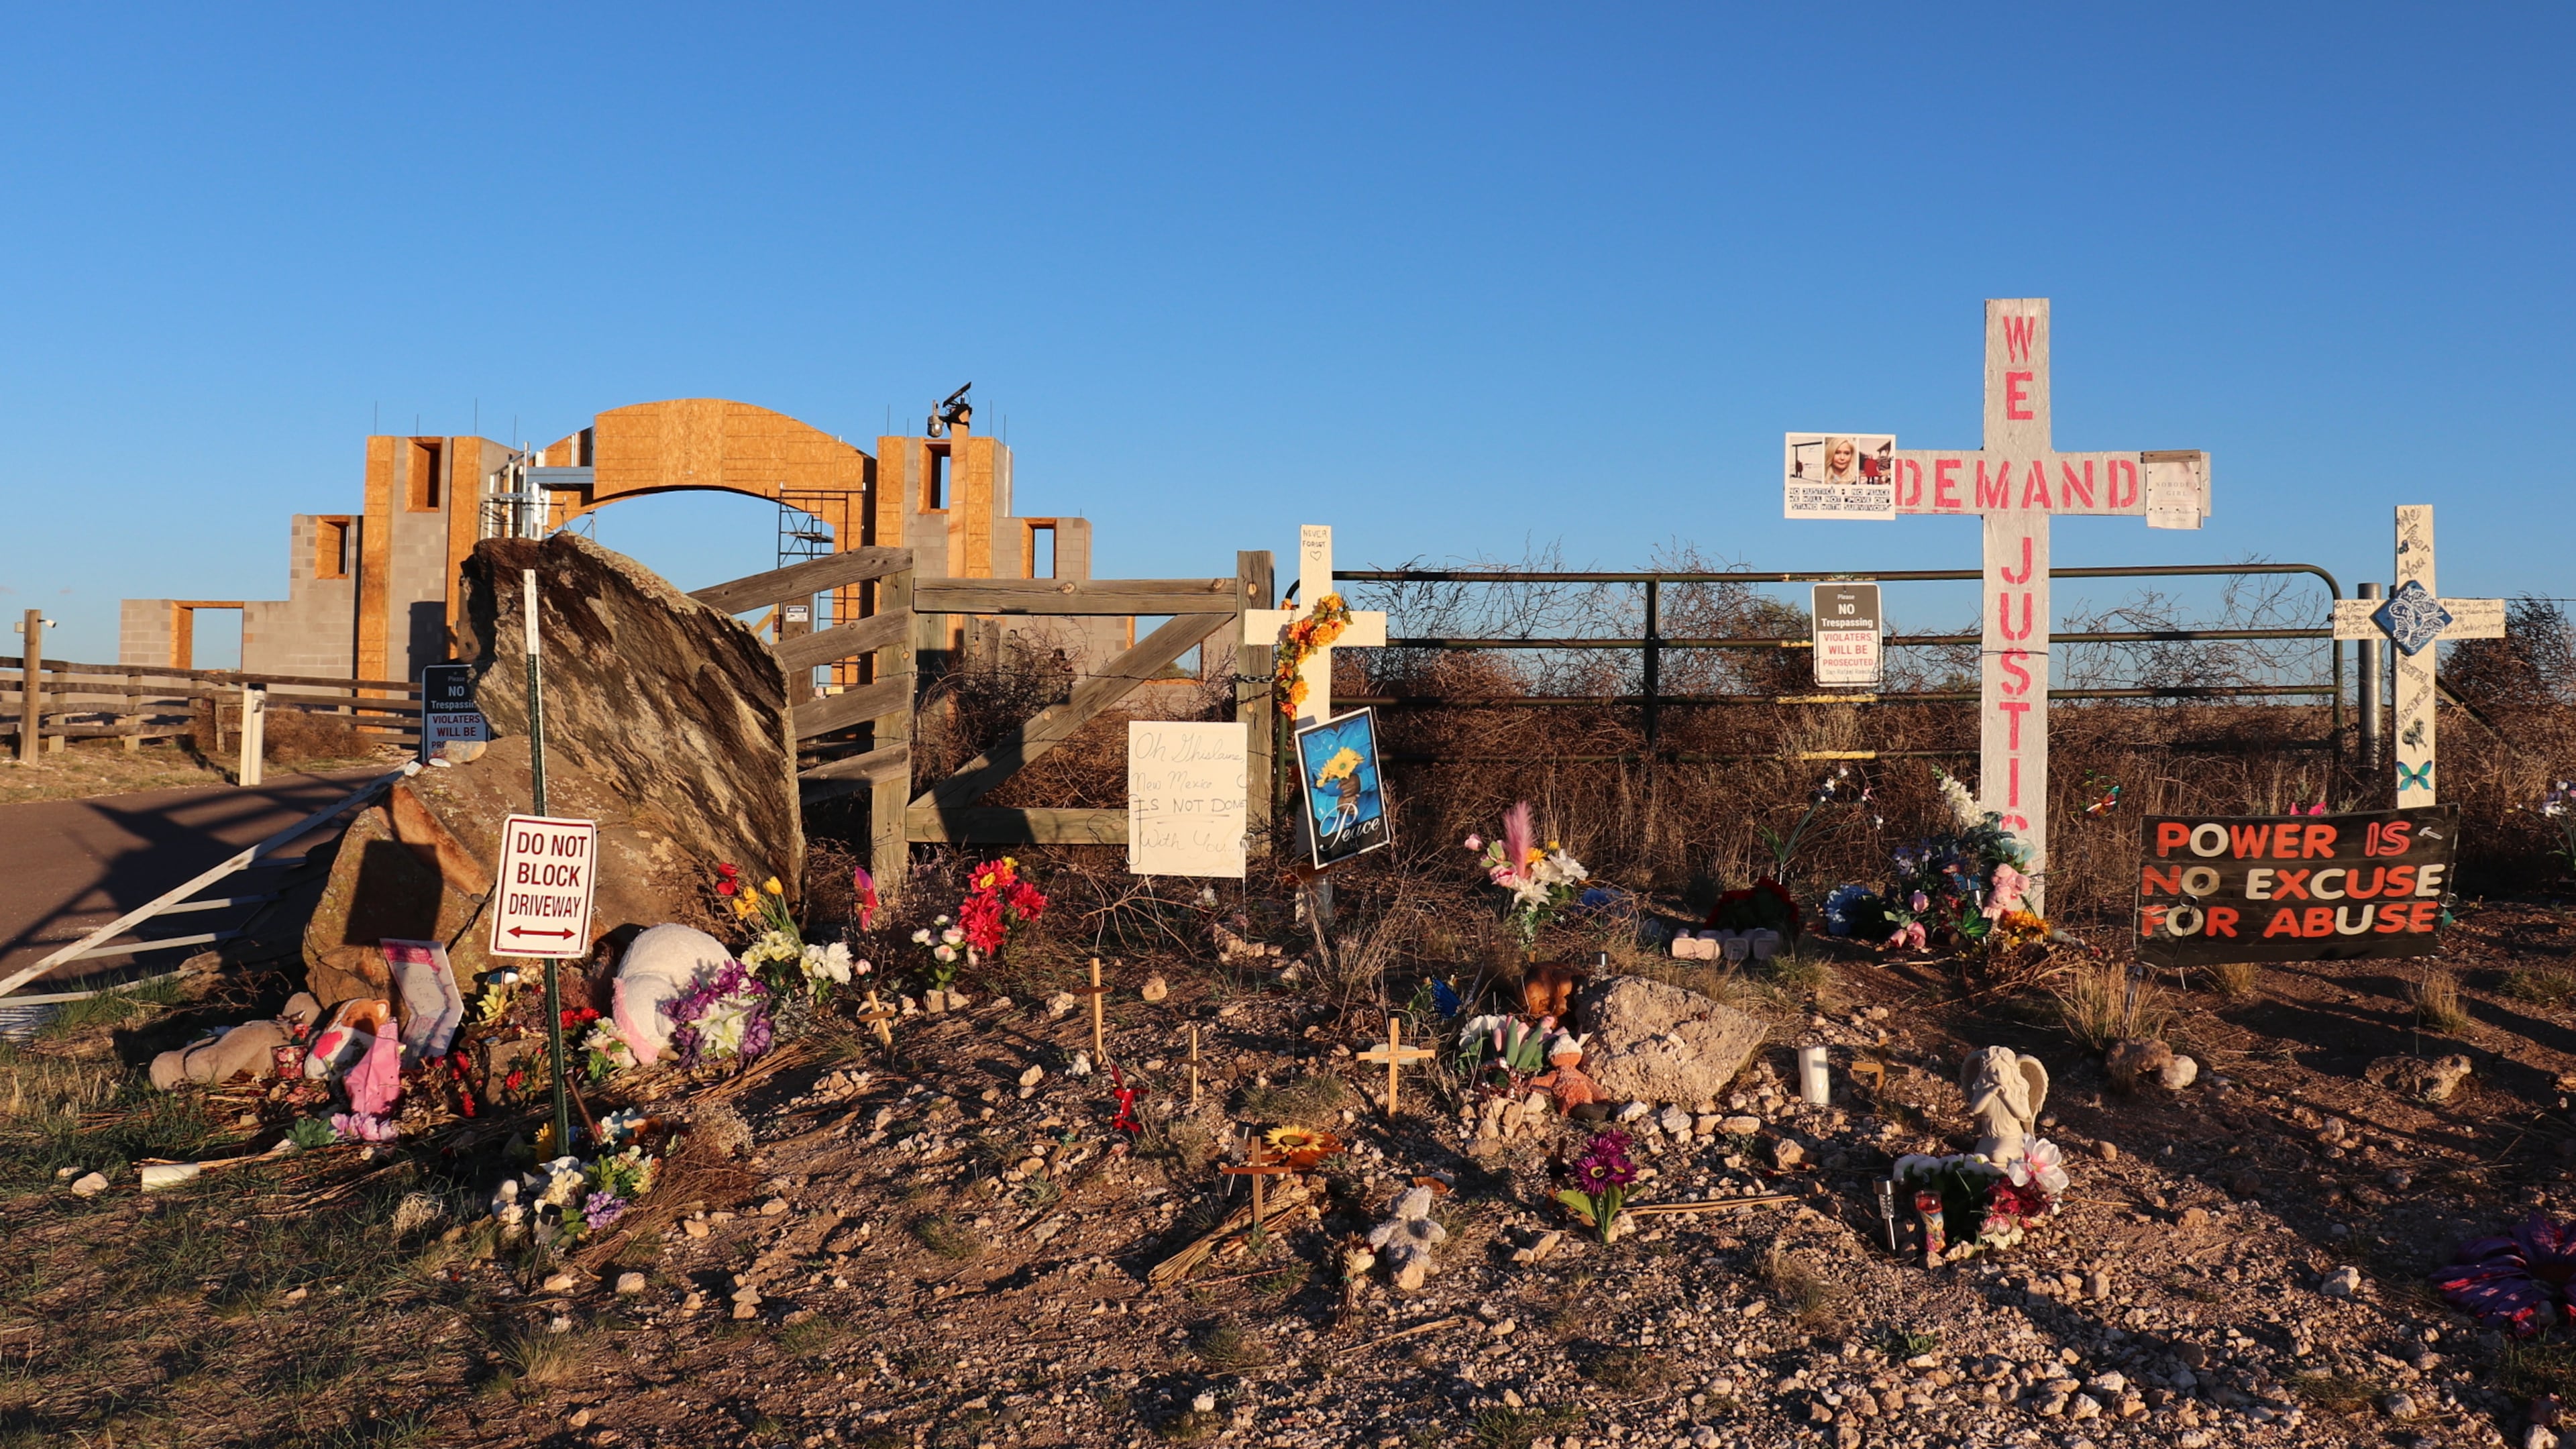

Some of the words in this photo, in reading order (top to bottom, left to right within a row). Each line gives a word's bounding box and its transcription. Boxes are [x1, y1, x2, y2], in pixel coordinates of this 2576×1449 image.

[2002, 315, 2035, 421] WE
[1895, 459, 2138, 509] DEMAND
[1302, 539, 1326, 548] FORGET
[1303, 529, 1328, 538] NEVER
[1838, 603, 1856, 614] NO
[1821, 617, 1874, 629] Trespassing
[1823, 633, 1872, 642] VIOLATERS
[1828, 645, 1852, 655] WILL
[1855, 645, 1868, 655] BE
[1823, 658, 1874, 666] PROSECUTED
[448, 686, 465, 697] NO
[431, 700, 476, 711] Trespassi
[1999, 537, 2032, 892] JUSTI
[433, 715, 480, 724] VIOLATERS
[437, 727, 461, 737] WILL
[464, 727, 476, 737] BE
[1135, 732, 1166, 762] Oh
[1132, 772, 1162, 792] New
[1168, 771, 1212, 791] Mexico
[1134, 798, 1159, 812] IS
[1173, 798, 1204, 813] NOT
[1212, 798, 1246, 812] DONE
[1319, 800, 1380, 851] Peace
[517, 832, 545, 855] DO
[551, 835, 588, 858] NOT
[1140, 829, 1185, 851] With
[2156, 822, 2337, 859] POWER
[2365, 820, 2412, 857] IS
[517, 862, 582, 887] BLOCK
[2141, 865, 2220, 896] NO
[2245, 863, 2446, 900] EXCUSE
[508, 893, 582, 918] DRIVEWAY
[2141, 904, 2240, 937] FOR
[2263, 901, 2438, 938] ABUSE
